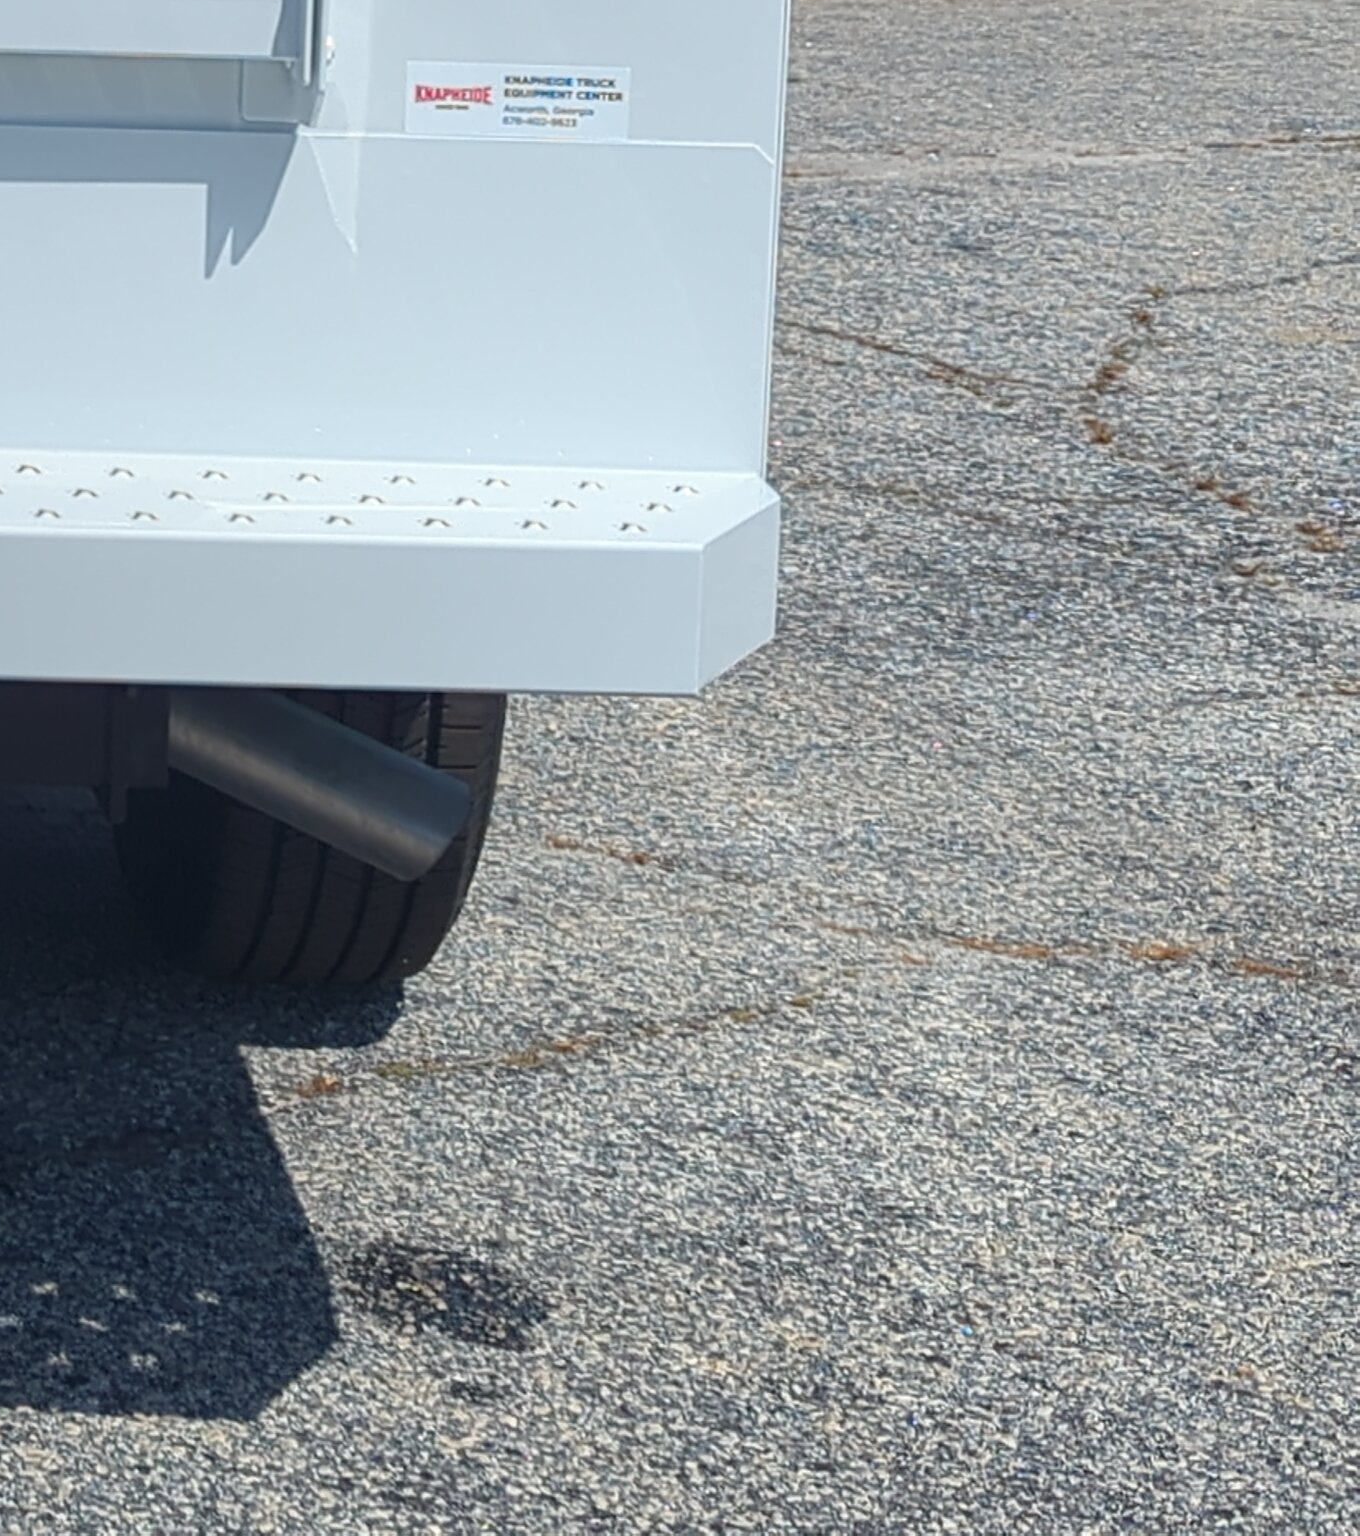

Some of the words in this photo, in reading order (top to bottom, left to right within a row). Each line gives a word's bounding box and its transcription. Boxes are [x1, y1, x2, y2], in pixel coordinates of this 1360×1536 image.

[504, 75, 574, 87] KNAPHEIDE
[577, 77, 616, 88] TRUCK
[414, 84, 494, 105] KNAPHEIDE
[504, 87, 573, 99] EQUIPMENT
[576, 90, 623, 101] CENTER
